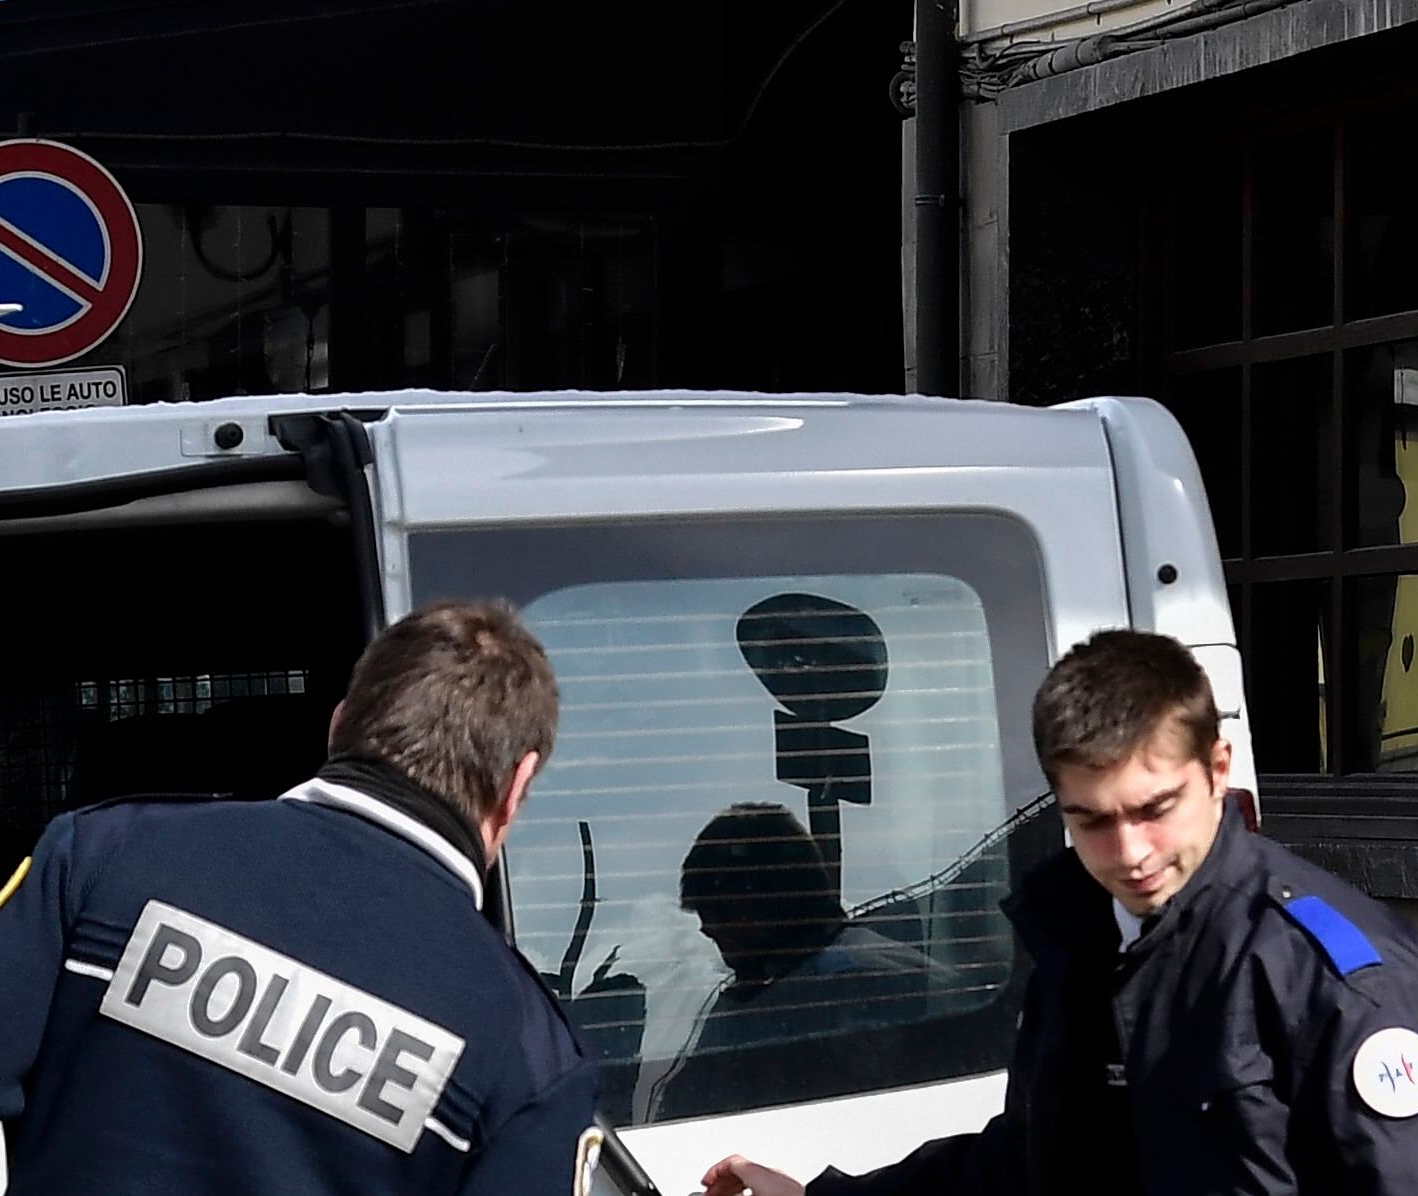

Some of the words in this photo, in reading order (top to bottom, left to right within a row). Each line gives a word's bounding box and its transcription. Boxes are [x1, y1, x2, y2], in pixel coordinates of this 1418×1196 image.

[39, 384, 61, 403] LE
[66, 380, 117, 401] AUTO
[124, 922, 436, 1128] POLICE
